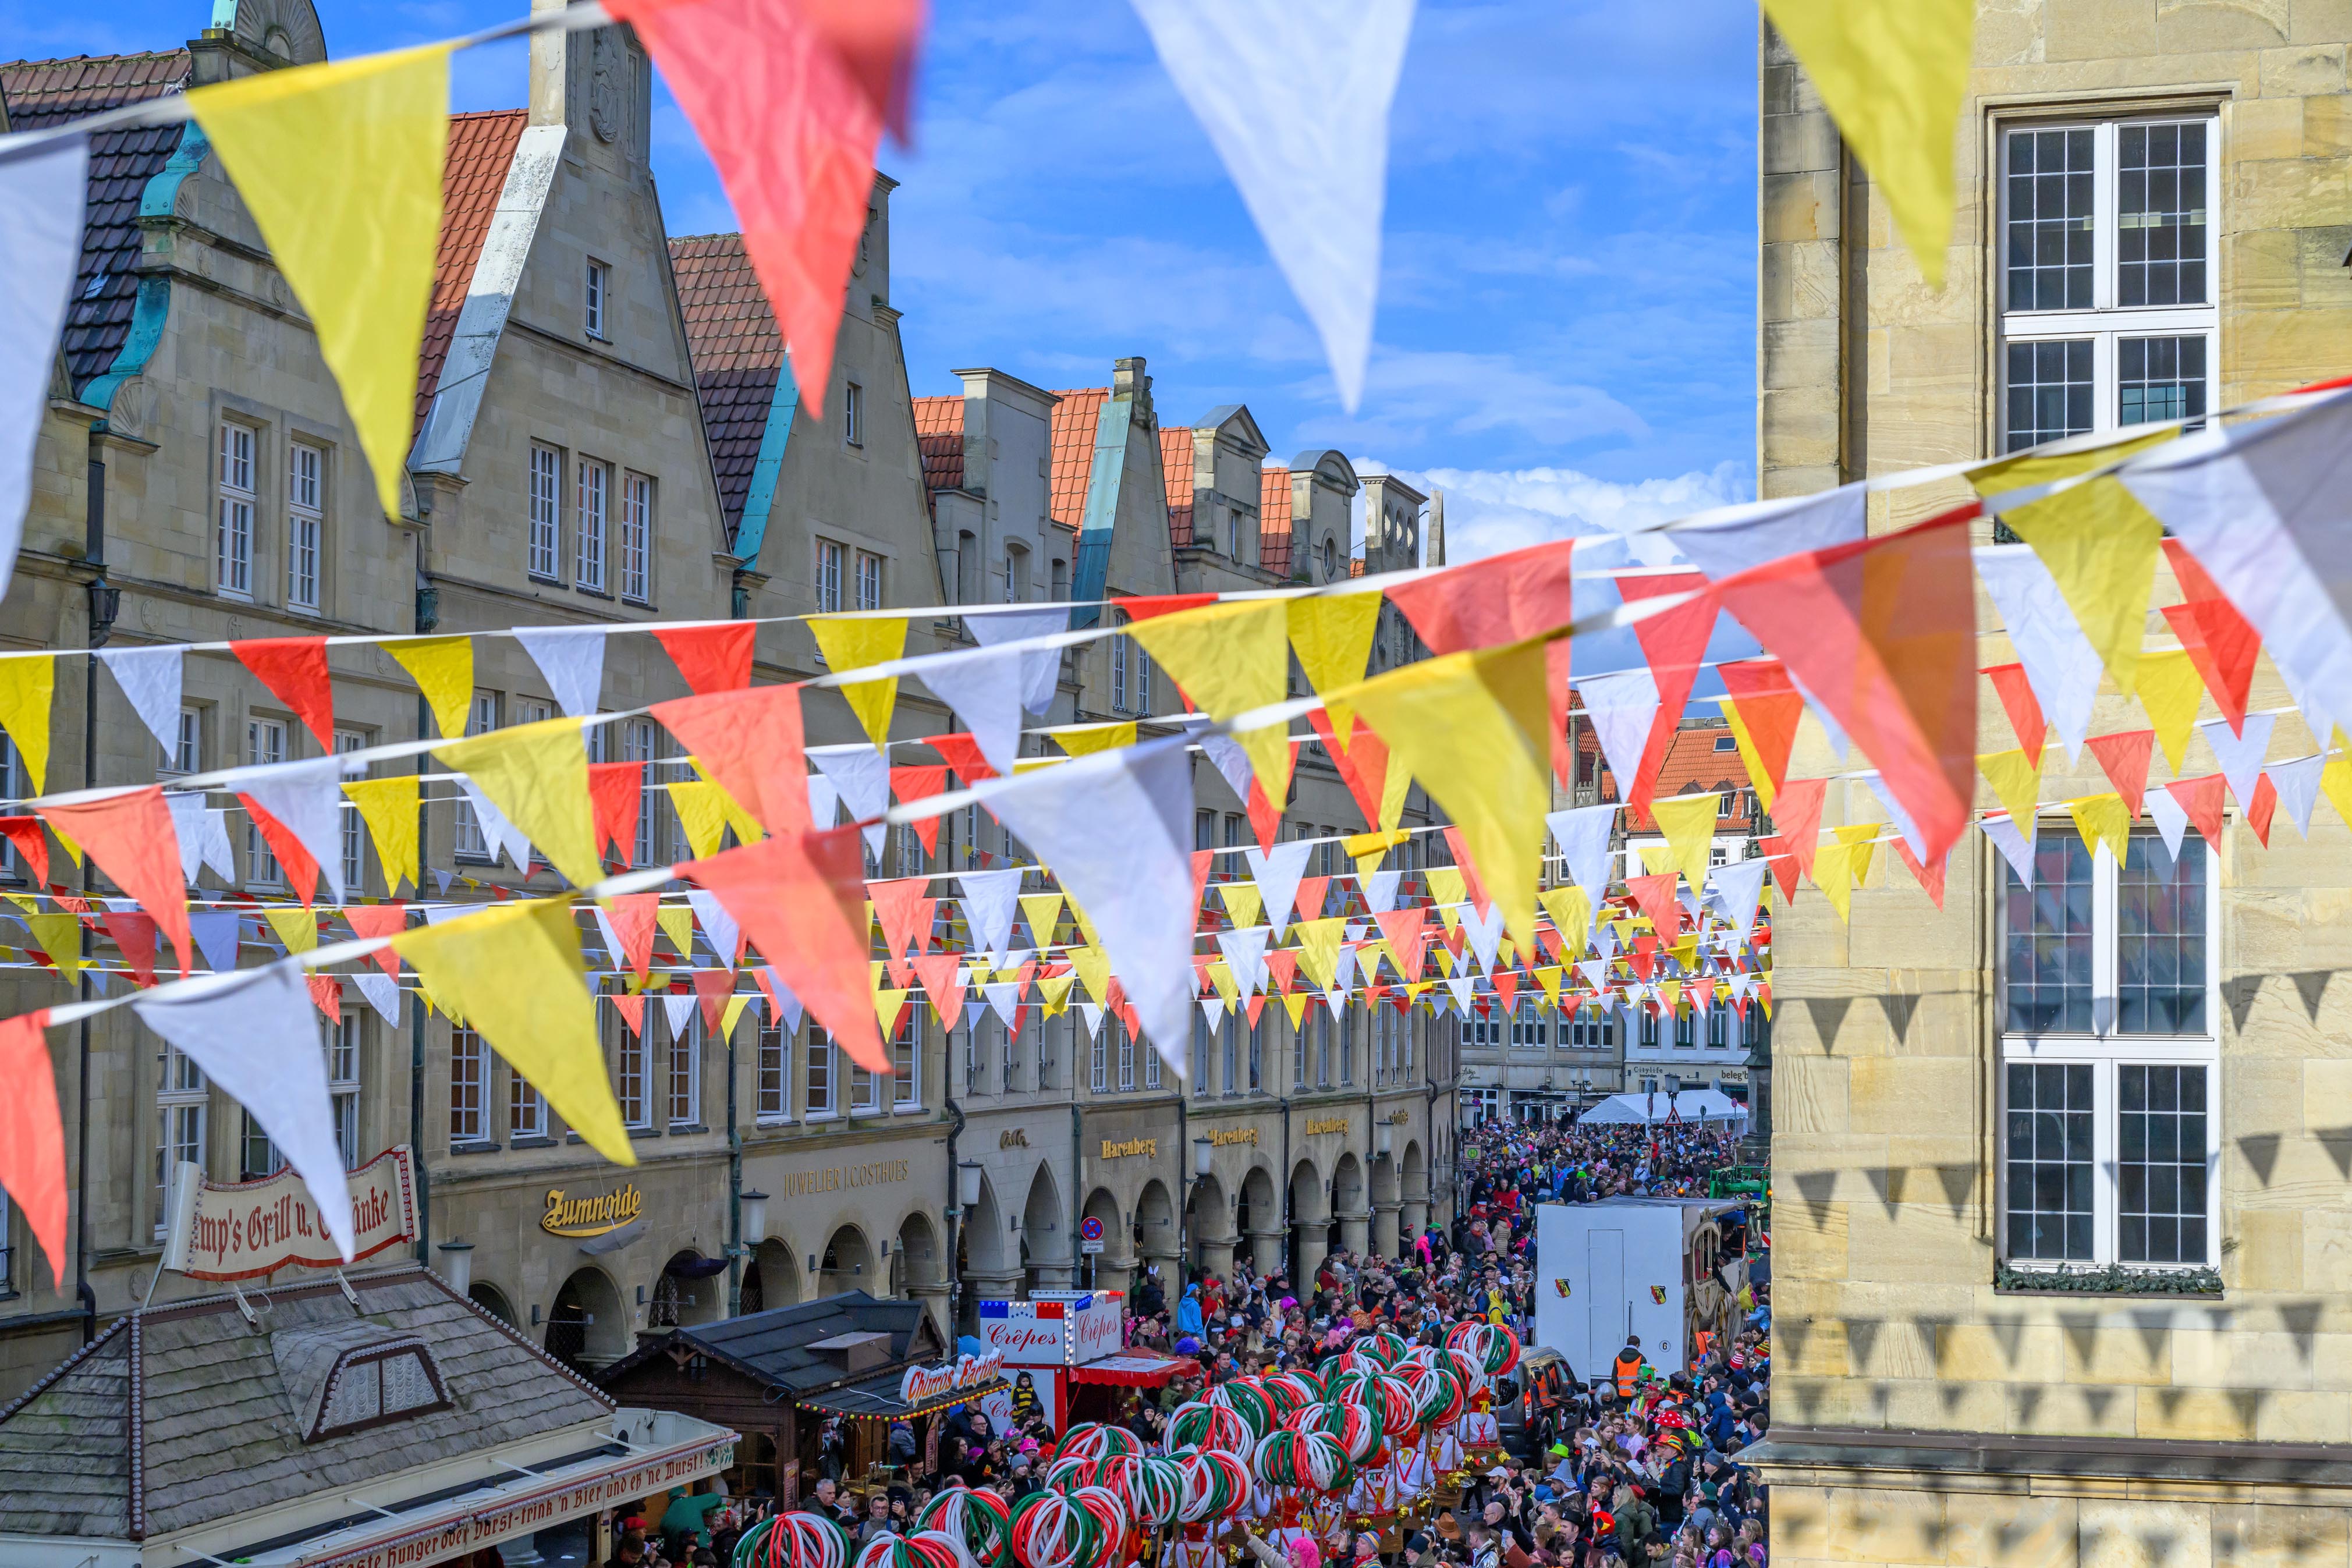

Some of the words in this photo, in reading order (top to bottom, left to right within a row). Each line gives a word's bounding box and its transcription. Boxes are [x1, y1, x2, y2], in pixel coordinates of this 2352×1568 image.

[1208, 1126, 1258, 1146] Harenberg
[1306, 1118, 1349, 1136] Harenberg
[1101, 1137, 1157, 1159] Harenberg
[783, 1168, 840, 1201] JUWELIER
[247, 1193, 291, 1251] Grill
[295, 1201, 312, 1237] u.
[542, 1183, 642, 1236] Zumnorde
[987, 1324, 1058, 1351] Crêpes
[1079, 1313, 1118, 1349] Crêpes
[907, 1370, 955, 1407] Churros
[958, 1353, 1005, 1387] Factory
[387, 1537, 439, 1568] Hunger
[573, 1484, 601, 1508] Bier
[606, 1476, 627, 1498] und
